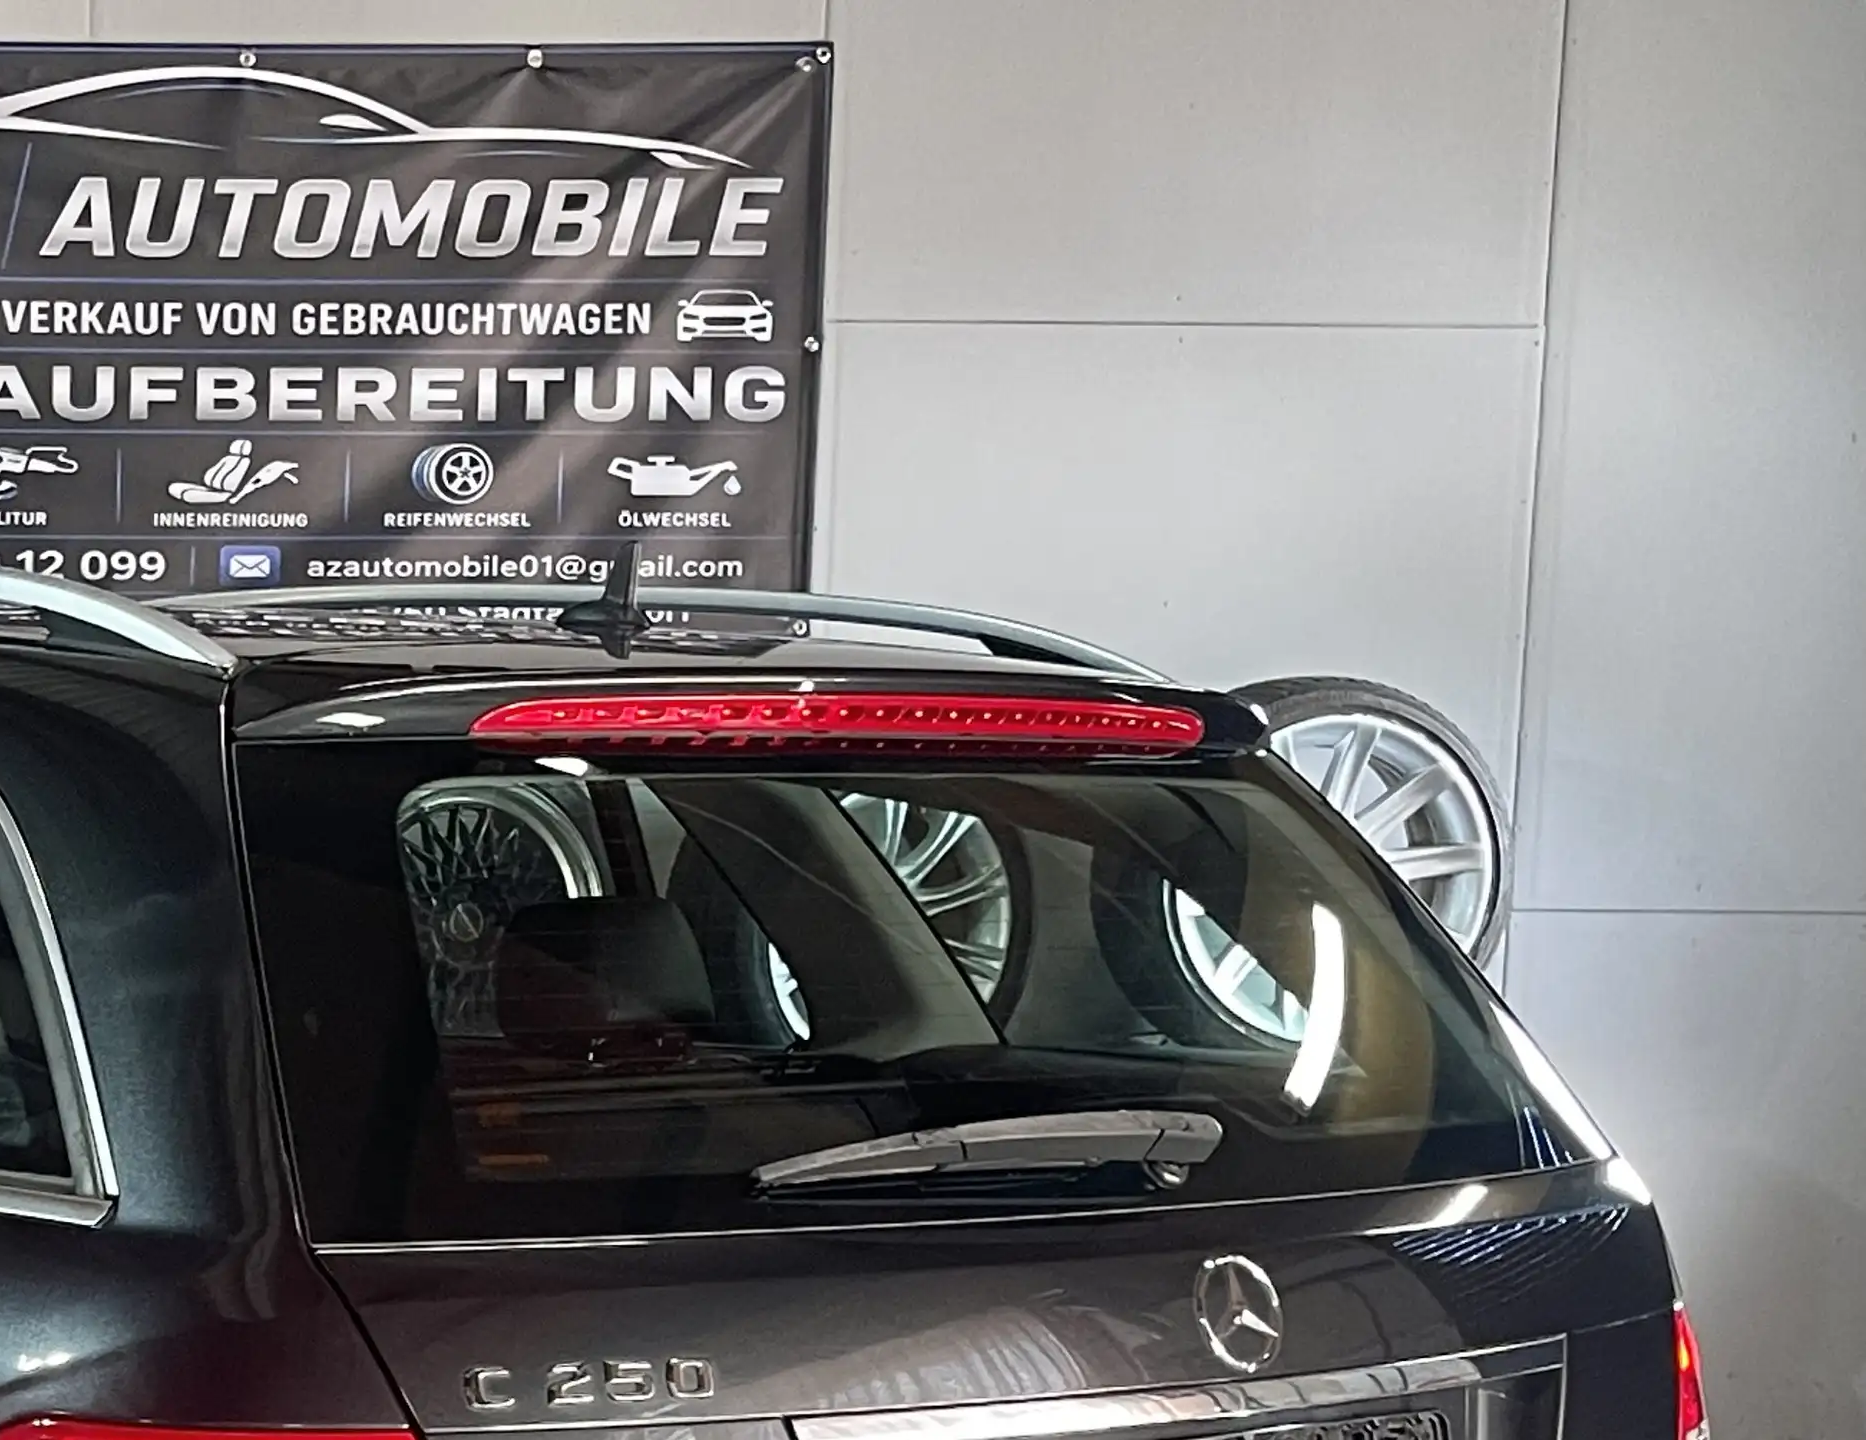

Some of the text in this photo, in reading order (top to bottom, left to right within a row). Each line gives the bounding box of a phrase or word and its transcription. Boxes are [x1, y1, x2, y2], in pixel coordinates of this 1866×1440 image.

[38, 176, 784, 258] AUTOMOBILE
[1, 300, 183, 335] VERKAUF
[196, 302, 276, 335] VON
[292, 302, 651, 336] GEBRAUCHTWAGEN
[153, 512, 309, 528] INNENREINIGUNG
[384, 512, 531, 528] REIFENWECHSEL
[618, 510, 732, 528] ÖLWECHSEL
[80, 550, 166, 581] 099
[307, 554, 743, 583] azautomobile01@gail.com
[463, 1357, 715, 1410] C 250
